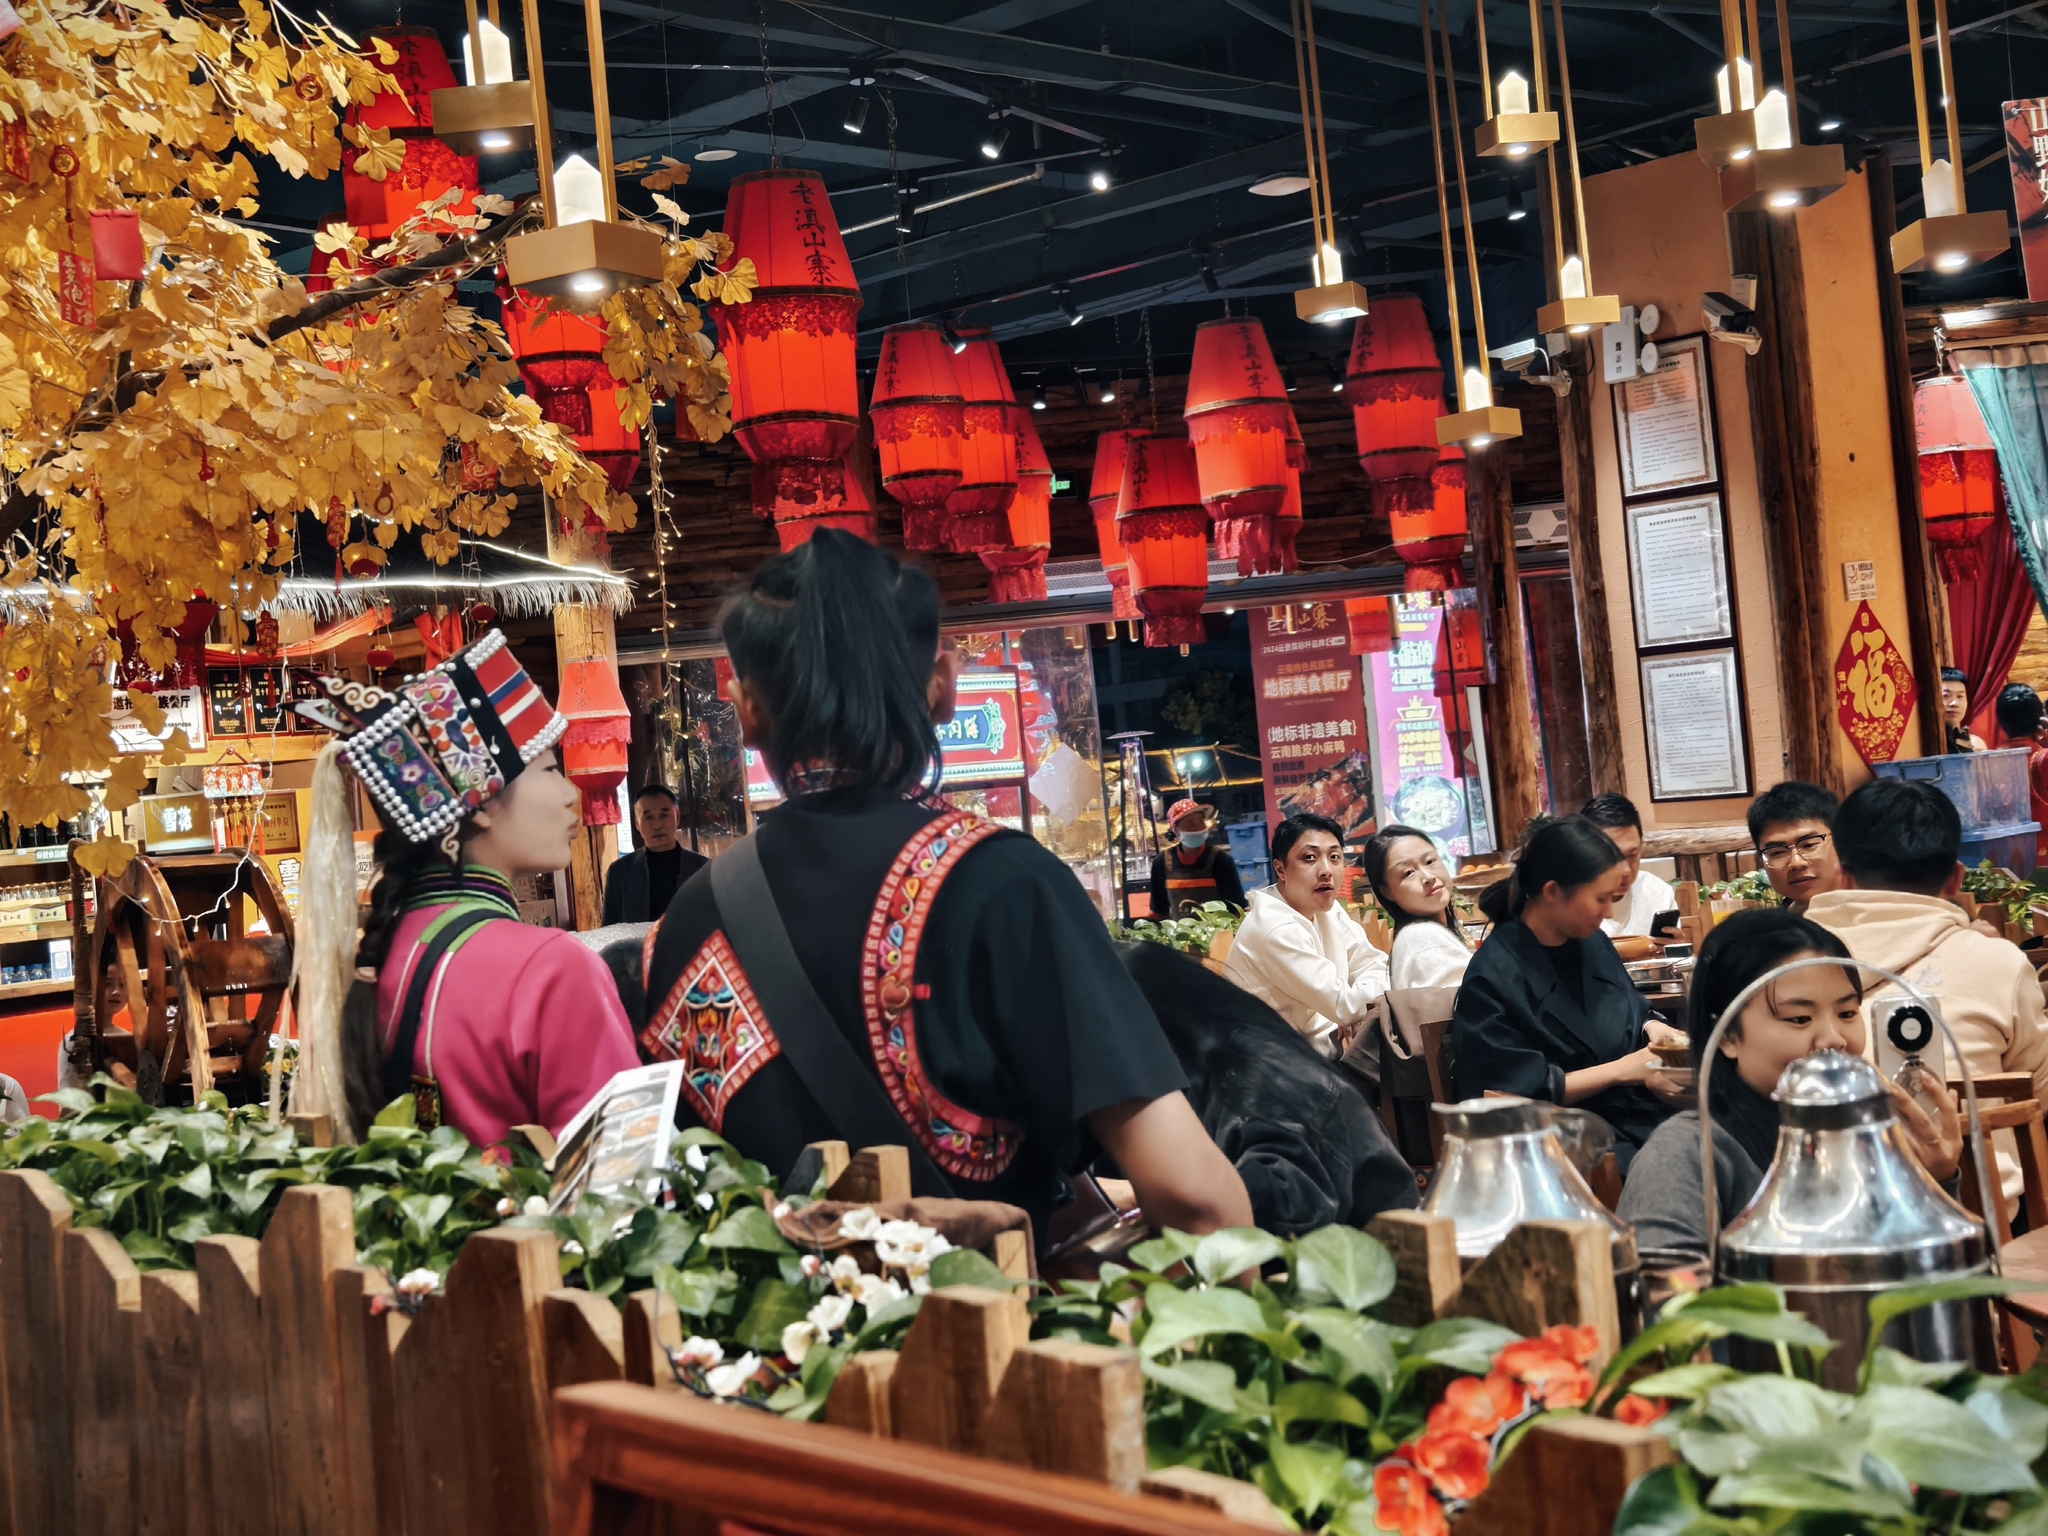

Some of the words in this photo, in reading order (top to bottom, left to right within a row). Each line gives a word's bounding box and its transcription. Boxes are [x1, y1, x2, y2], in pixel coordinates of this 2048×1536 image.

[790, 180, 840, 285] 老滇山寨
[1056, 480, 1071, 490] EXIT
[1264, 670, 1351, 698] 地标美食餐厅
[1847, 629, 1896, 719] 福
[1267, 719, 1357, 744] {地标非遗美食}
[1270, 740, 1345, 759] 云南脆皮小麻鸭
